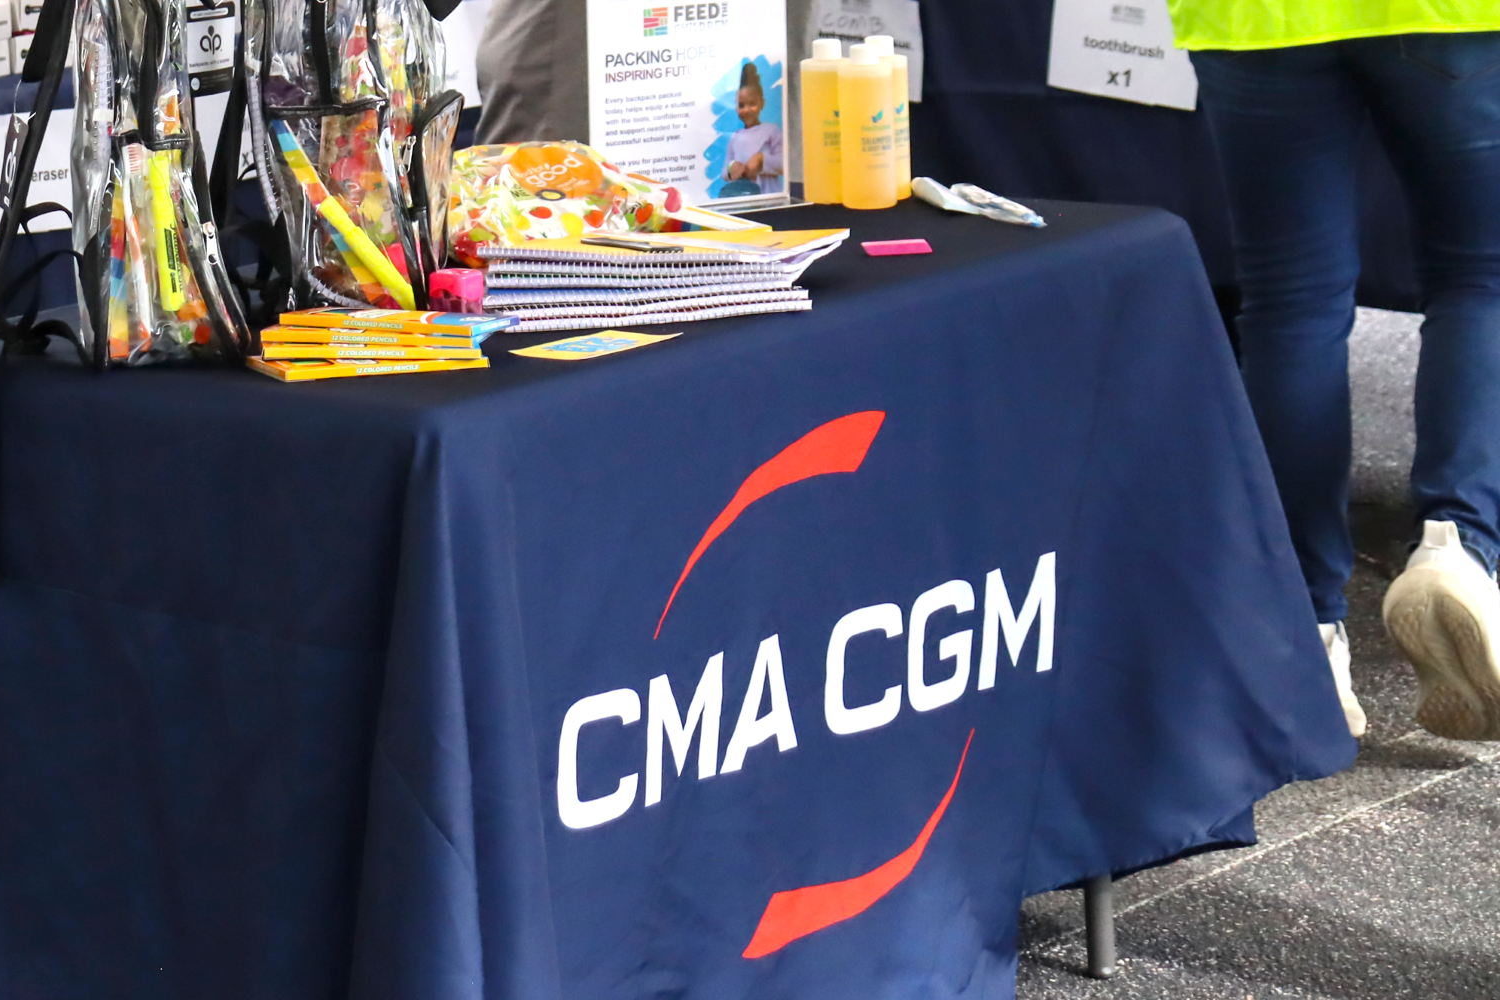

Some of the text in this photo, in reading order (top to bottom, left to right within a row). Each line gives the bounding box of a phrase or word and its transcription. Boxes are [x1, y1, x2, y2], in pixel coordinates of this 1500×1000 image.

[674, 2, 720, 22] FEED
[1083, 35, 1165, 60] toothbrush
[605, 49, 672, 68] PACKING
[605, 68, 662, 84] INSPIRING
[1106, 68, 1132, 88] x1
[605, 91, 682, 105] Every backpack packed
[605, 108, 624, 116] today
[645, 104, 663, 112] equip
[670, 100, 696, 108] student
[619, 127, 646, 136] support
[647, 124, 671, 132] needed
[605, 137, 642, 147] successful
[643, 135, 665, 144] school
[628, 159, 641, 167] you
[652, 155, 679, 164] packing
[680, 153, 696, 161] hope
[30, 168, 69, 183] eraser
[525, 154, 583, 188] good
[669, 165, 687, 173] today
[349, 320, 379, 328] COLORED
[378, 321, 404, 330] PENCILS
[338, 335, 369, 343] COLORED
[368, 335, 399, 343] PENCILS
[344, 349, 377, 357] COLORED
[377, 349, 406, 357] PENCILS
[363, 365, 393, 373] COLORED
[393, 363, 420, 372] PENCILS
[556, 550, 1057, 830] CMA CGM
